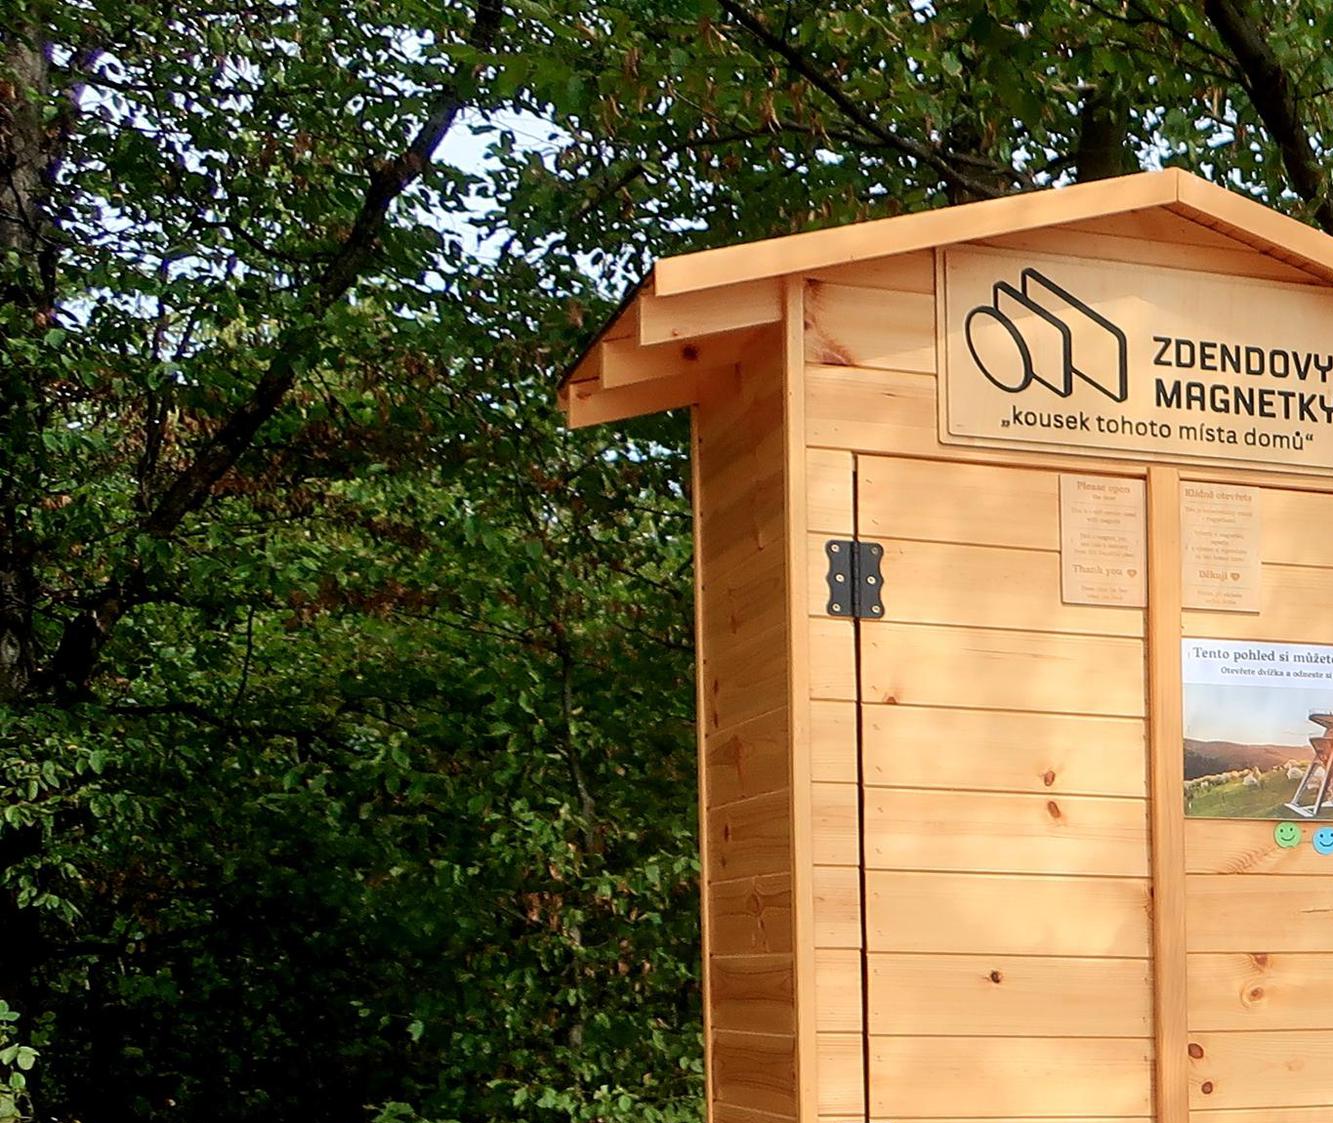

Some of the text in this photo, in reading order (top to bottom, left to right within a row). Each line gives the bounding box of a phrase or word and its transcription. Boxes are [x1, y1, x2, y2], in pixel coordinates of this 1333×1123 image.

[1153, 336, 1333, 383] ZDENDOVY
[1097, 414, 1171, 438] tohoto
[1179, 422, 1237, 445] místa
[1192, 646, 1230, 659] Tento
[1233, 649, 1275, 663] pohled
[1279, 651, 1289, 662] si
